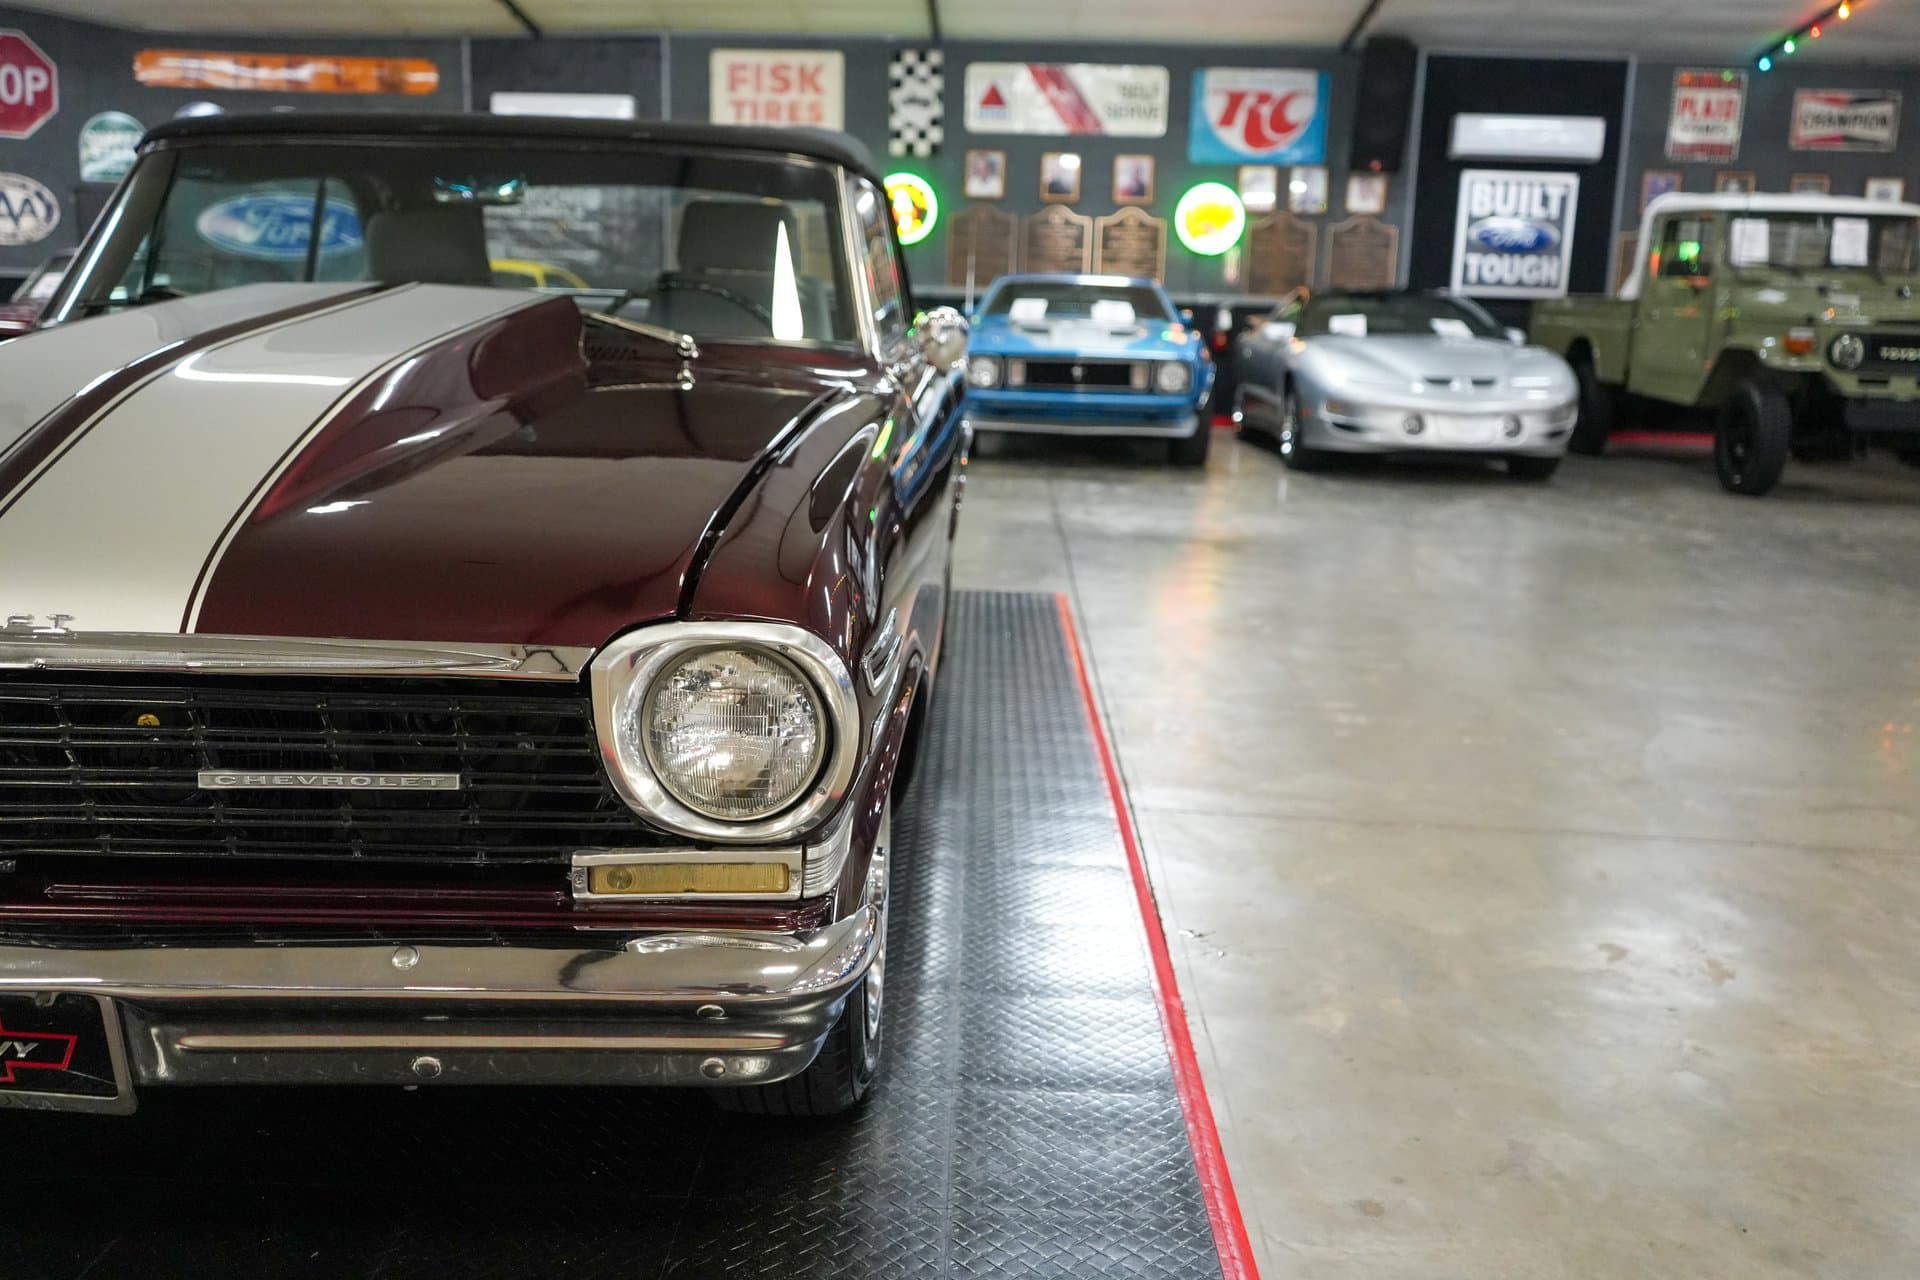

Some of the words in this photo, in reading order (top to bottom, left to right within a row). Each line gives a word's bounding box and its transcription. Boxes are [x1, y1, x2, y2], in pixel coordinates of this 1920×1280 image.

[728, 63, 824, 95] FISK
[729, 99, 825, 123] TIRES
[1214, 88, 1312, 148] RC
[1470, 182, 1568, 220] BUILT
[1466, 252, 1561, 286] TOUGH
[214, 775, 443, 787] CHEVROLET
